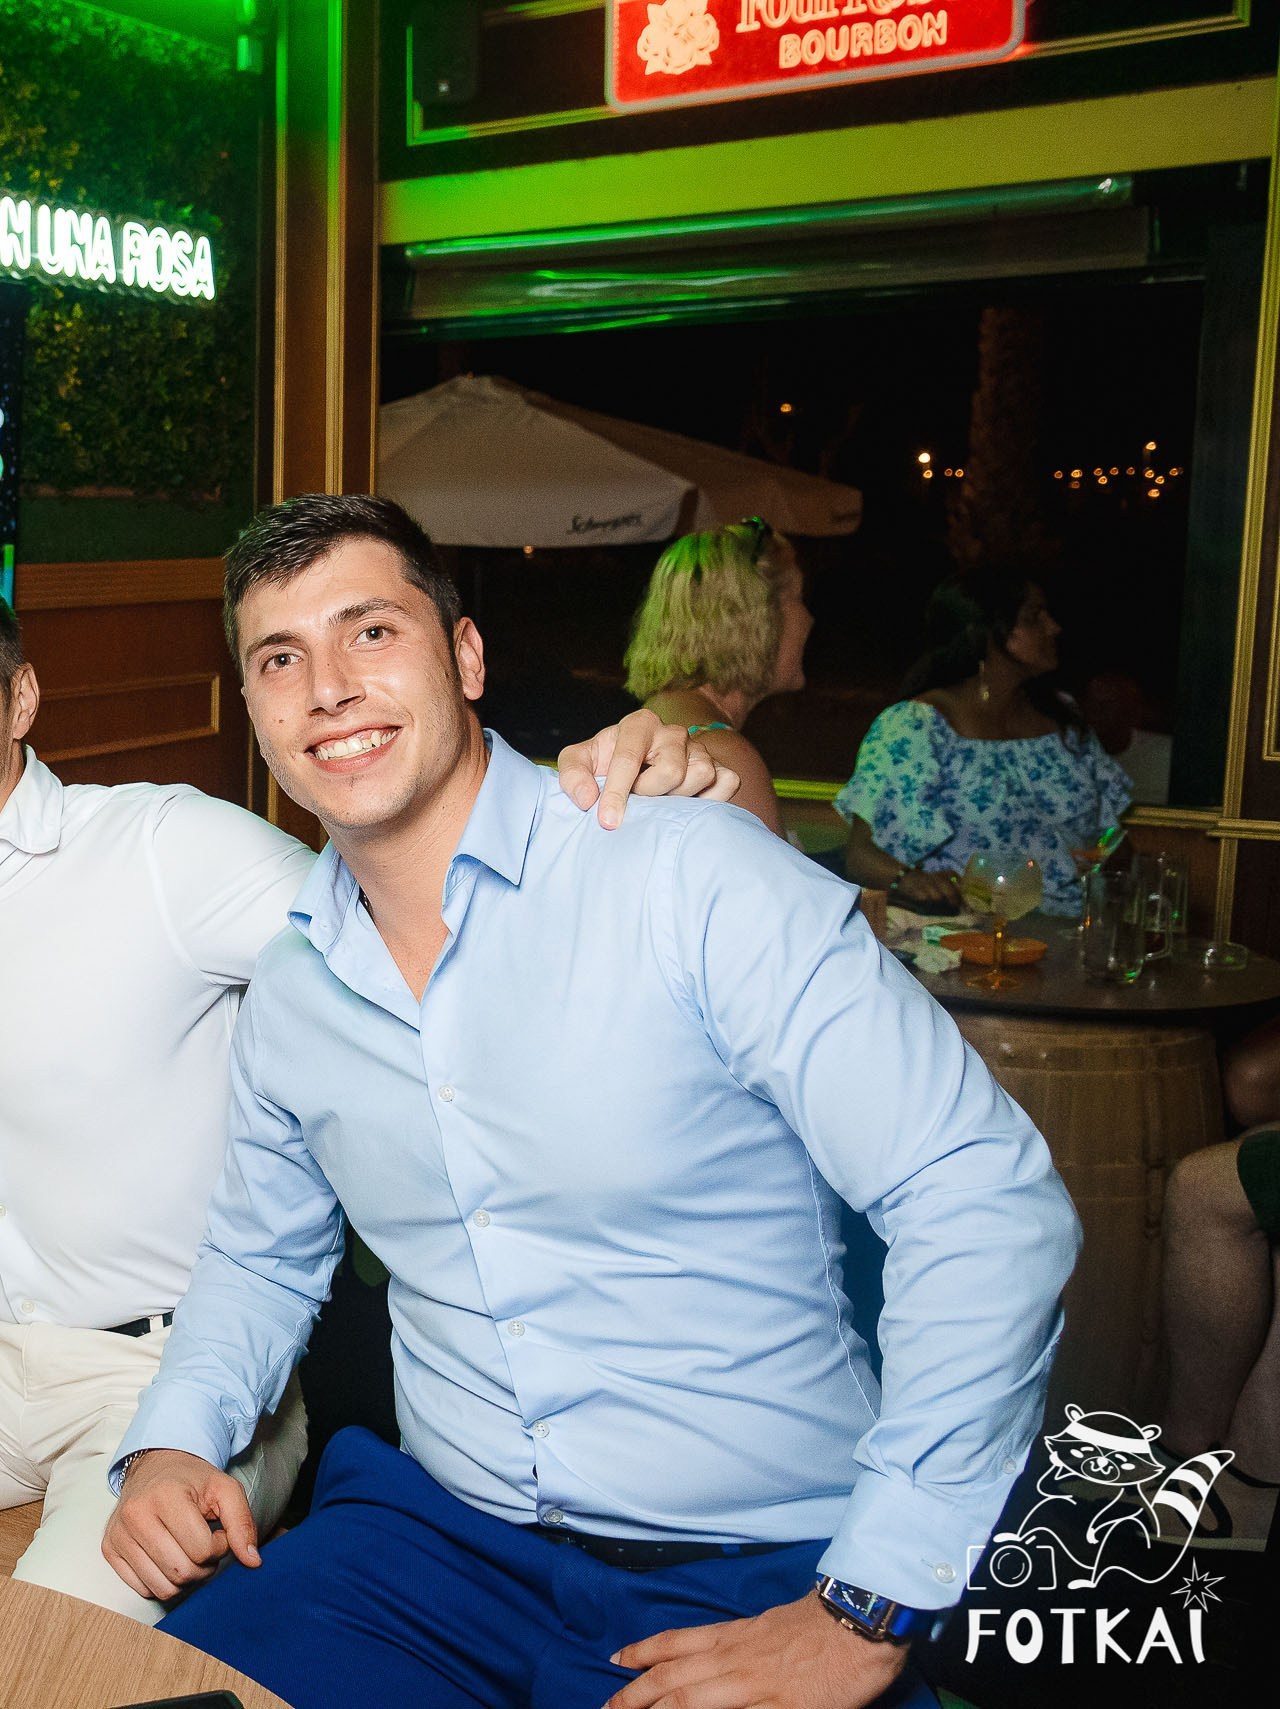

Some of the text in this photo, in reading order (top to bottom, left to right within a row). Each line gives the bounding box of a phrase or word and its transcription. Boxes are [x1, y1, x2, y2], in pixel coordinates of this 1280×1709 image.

[779, 9, 948, 70] BOURBON
[38, 204, 116, 284] UNA
[123, 220, 216, 300] ROSA
